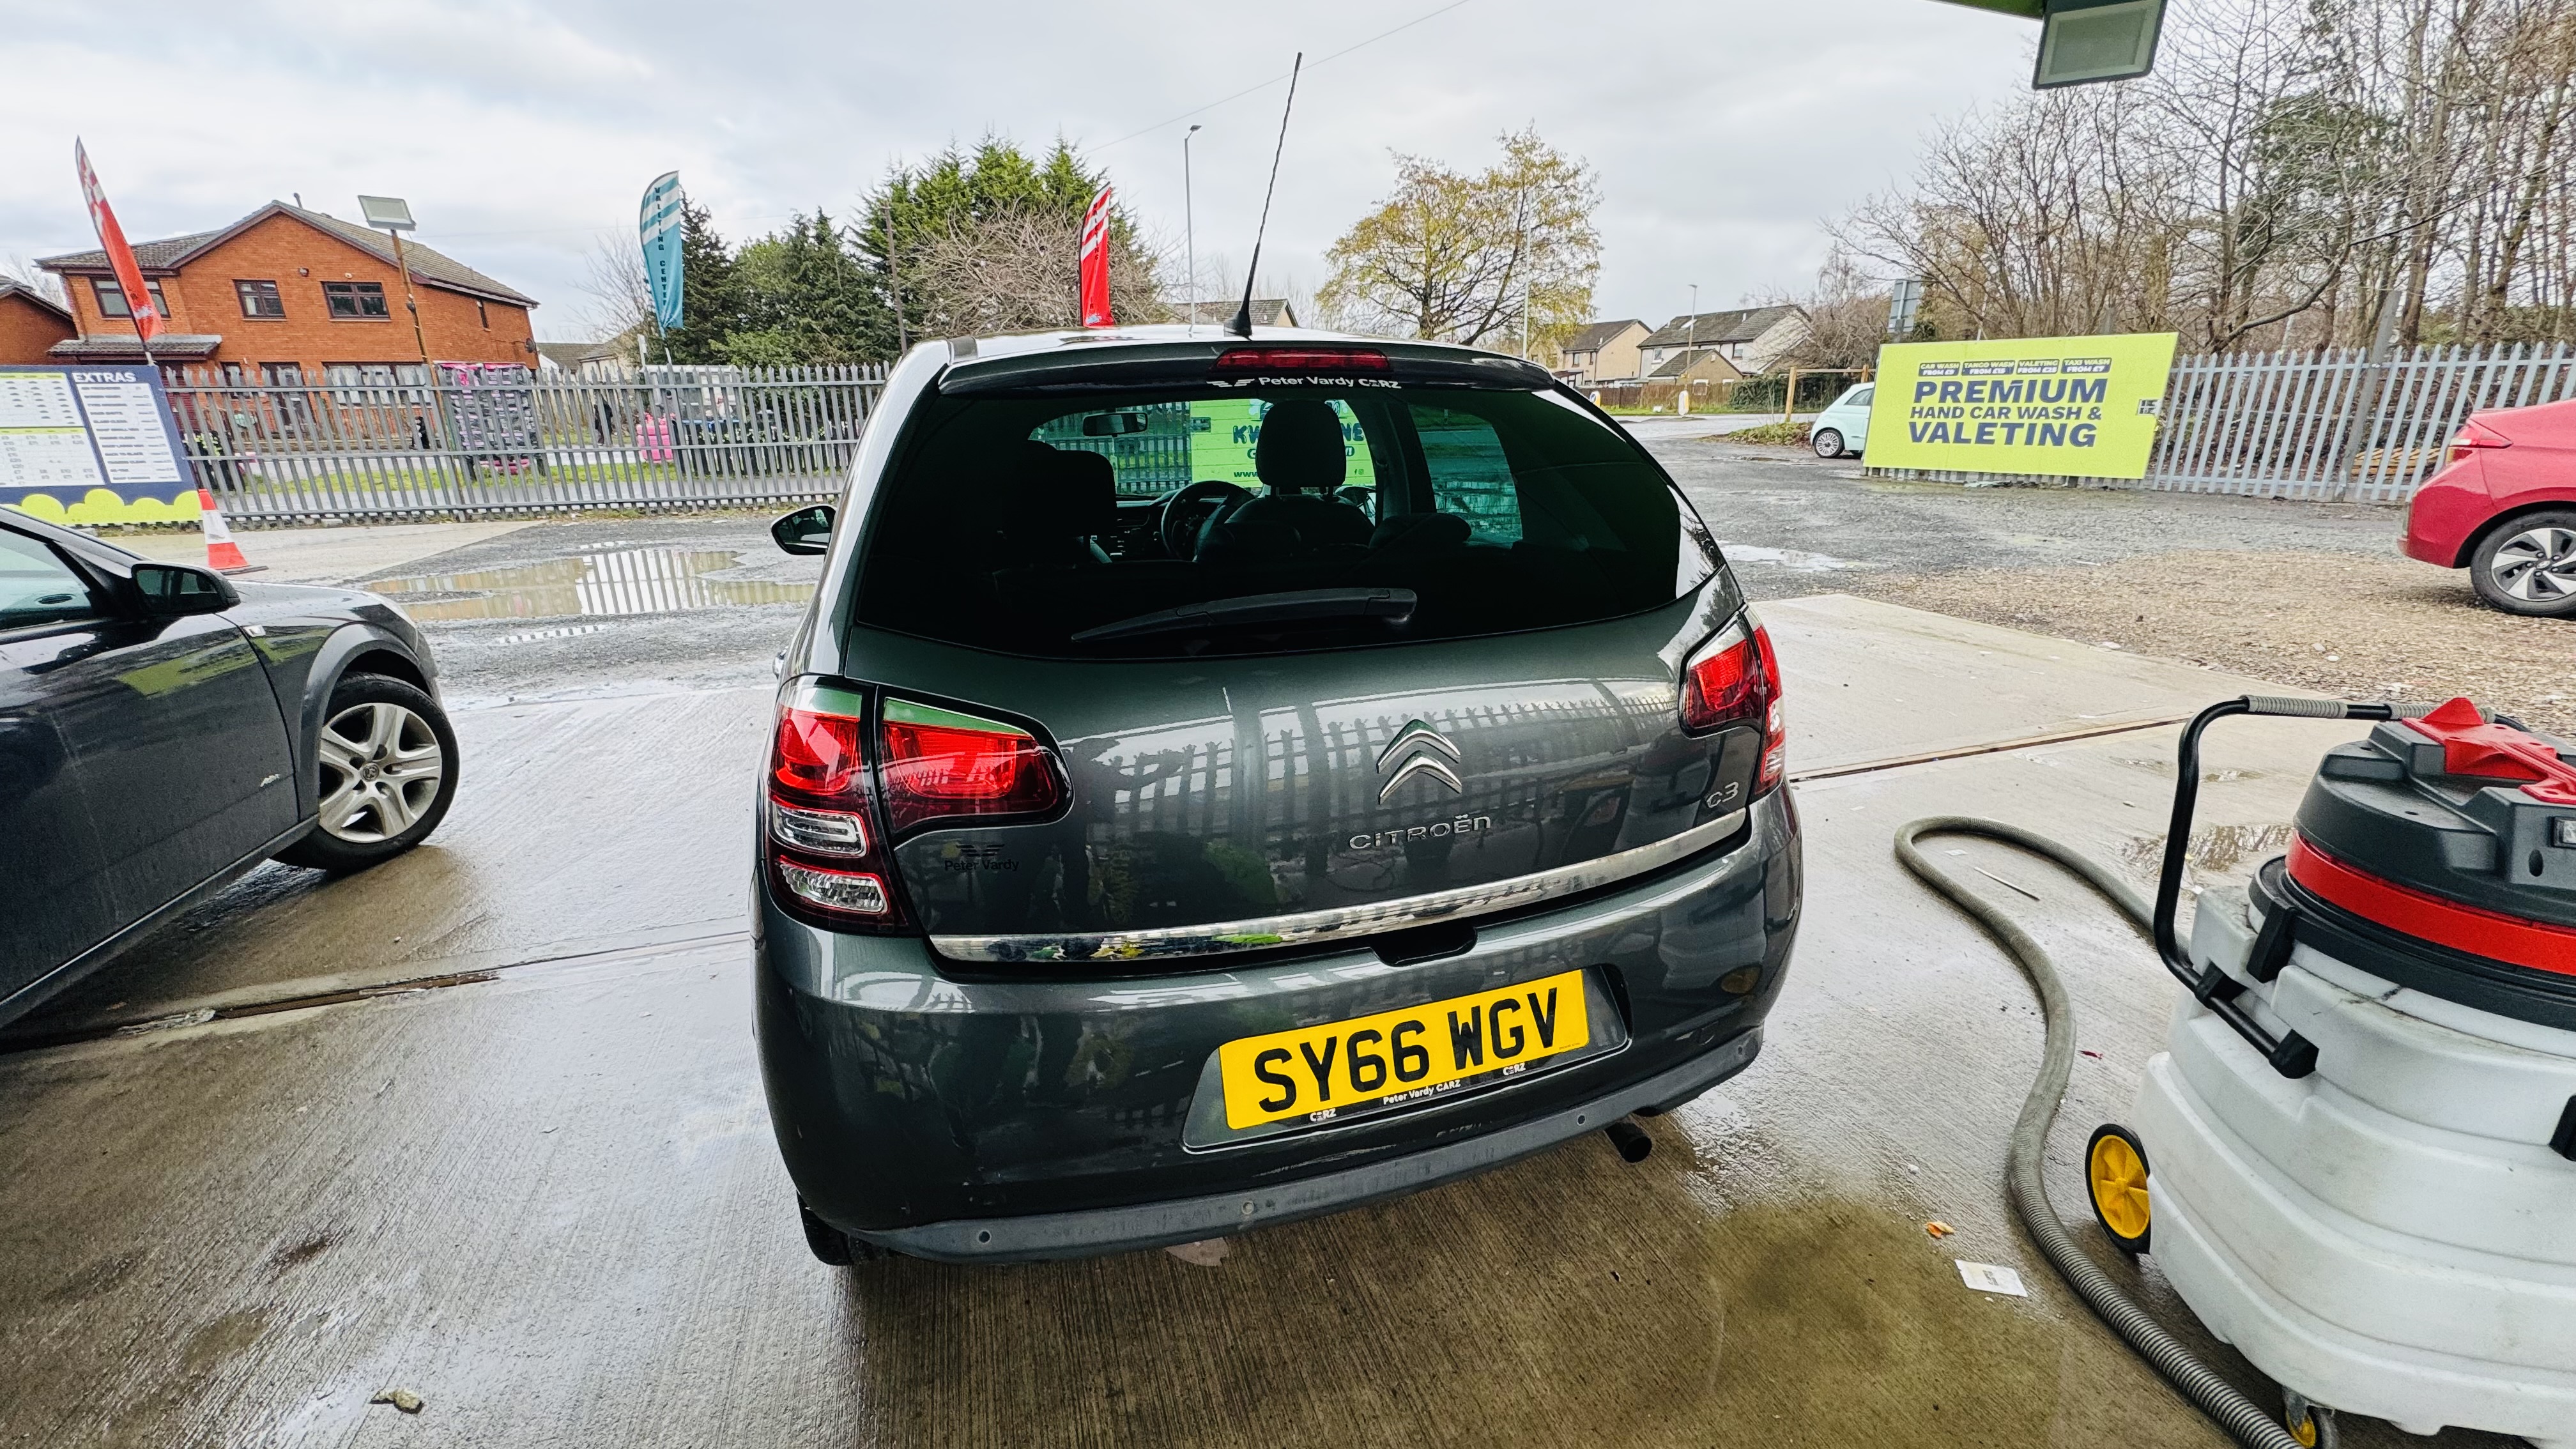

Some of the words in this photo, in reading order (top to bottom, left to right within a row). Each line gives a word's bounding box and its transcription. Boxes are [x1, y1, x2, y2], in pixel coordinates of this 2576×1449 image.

[654, 187, 664, 250] VALETING
[72, 372, 137, 383] EXTRAS
[1259, 376, 1304, 385] Peter
[1306, 376, 1354, 387] Vardy
[1913, 378, 2108, 404] PREMIUM
[1910, 406, 1965, 419] HAND
[1970, 406, 2012, 420] CAR
[2017, 406, 2083, 420] WASH
[2087, 406, 2102, 420] &
[1909, 421, 2097, 447] VALETING
[1706, 781, 1739, 808] C3
[944, 859, 978, 871] Peter
[981, 859, 1020, 872] Vardy
[1254, 1020, 1431, 1114] SY66
[1447, 987, 1558, 1071] WGV
[1383, 1093, 1407, 1105] Peter
[1409, 1086, 1434, 1099] Vardy
[1436, 1079, 1461, 1092] CARZ
